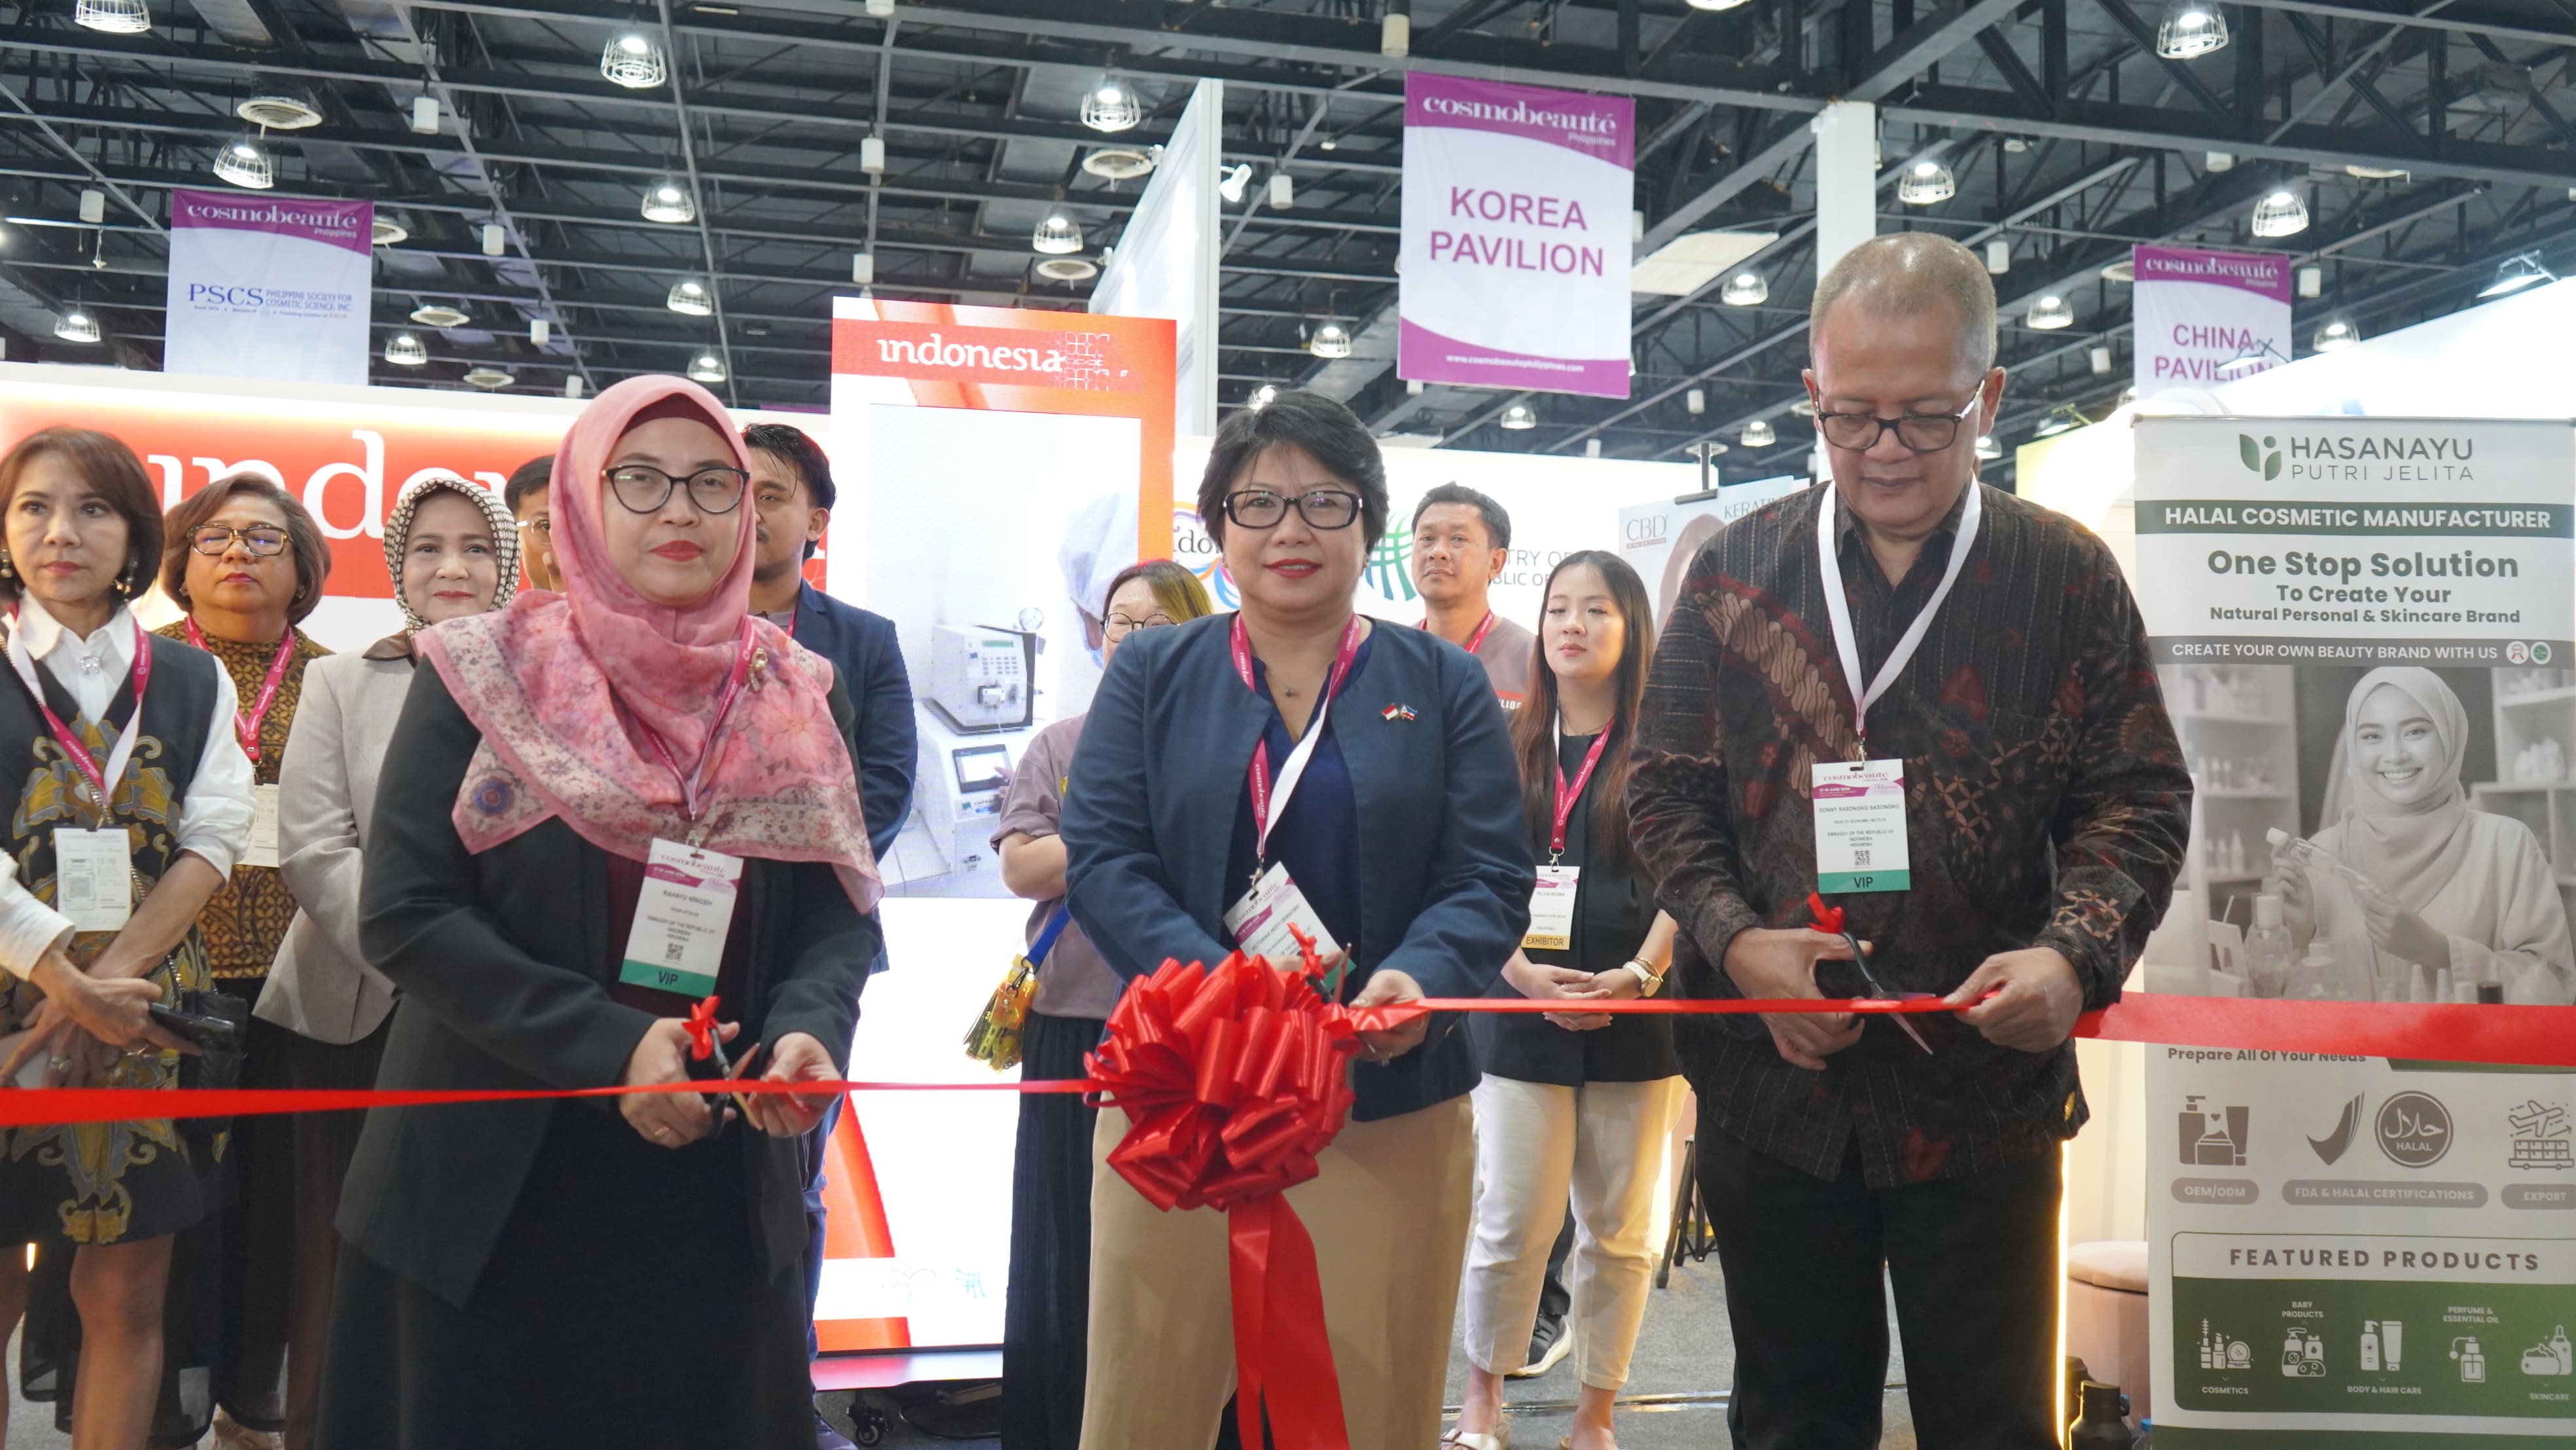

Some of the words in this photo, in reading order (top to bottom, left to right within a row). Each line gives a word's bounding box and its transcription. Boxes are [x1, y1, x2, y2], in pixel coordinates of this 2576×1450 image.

[1423, 96, 1617, 134] cosmobeauté
[1568, 132, 1616, 147] Philippines
[1451, 186, 1586, 230] KOREA
[188, 205, 357, 228] cosmobeauté
[314, 226, 356, 238] Philippines
[1430, 231, 1603, 276] PAVILION
[188, 283, 264, 306] PSCS
[266, 289, 304, 300] PHILIPPINE
[308, 292, 335, 302] SOCIETY
[266, 299, 301, 308] COSMETIC
[2173, 325, 2254, 349] CHINA
[2291, 436, 2473, 461] HASANAYU
[2292, 465, 2367, 481] PUTRI
[2384, 467, 2474, 482] JELITA
[2165, 506, 2238, 525] HALAL
[2242, 508, 2358, 527] COSMETIC
[2364, 510, 2550, 529] MANUFACTURER
[1626, 515, 1667, 541] CBD
[2208, 550, 2276, 575] One
[2285, 551, 2361, 585] Stop
[2371, 551, 2518, 578] Solution
[2276, 585, 2302, 601] To
[2308, 586, 2388, 603] Create
[2394, 587, 2452, 603] Your
[2210, 607, 2278, 621] Natural
[2283, 609, 2358, 622] Personal
[2364, 610, 2375, 622] &
[2380, 610, 2462, 624] Skincare
[2467, 610, 2520, 624] Brand
[2172, 644, 2230, 656] CREATE
[2234, 644, 2274, 656] YOUR
[2278, 645, 2314, 658] OWN
[2319, 646, 2373, 659] BEAUTY
[2378, 646, 2431, 659] BRAND
[2435, 646, 2474, 659] WITH
[2478, 646, 2497, 659] US
[1853, 877, 1873, 888] VIP
[1526, 937, 1564, 946] EXHIBITOR
[658, 971, 678, 985] VIP
[2168, 1048, 2232, 1063] Prepare
[2237, 1050, 2256, 1061] All
[2280, 1052, 2315, 1061] Your
[2396, 1141, 2433, 1152] HALAL
[2185, 1186, 2245, 1198] OEM/ODM
[2295, 1187, 2318, 1198] FDA
[2321, 1188, 2330, 1198] &
[2333, 1188, 2371, 1199] HALAL
[2373, 1188, 2475, 1201] CERTIFICATIONS
[2524, 1191, 2566, 1202] EXPORT
[2229, 1248, 2371, 1267] FEATURED
[2384, 1251, 2540, 1271] PRODUCTS
[2281, 1310, 2323, 1319] PRODUCTS
[2443, 1315, 2484, 1323] ESSENTIAL
[2202, 1387, 2249, 1395] COSMETICS
[2530, 1393, 2569, 1402] SKINCARE
